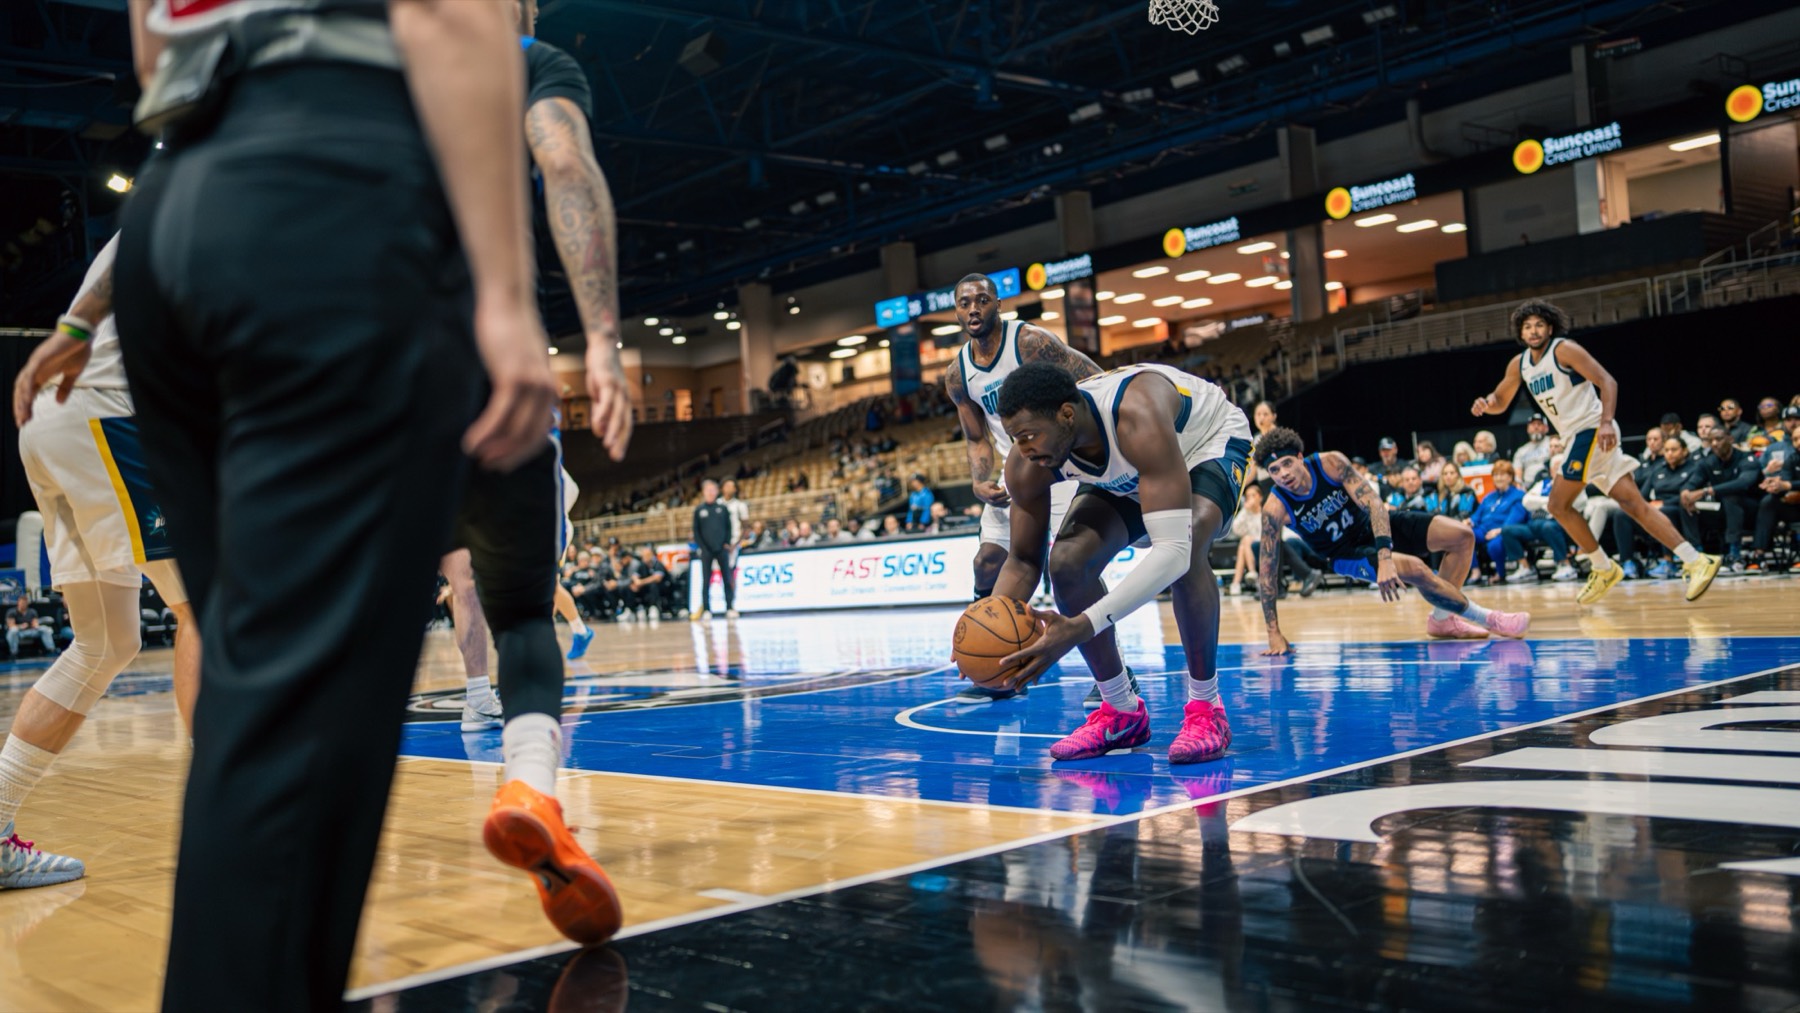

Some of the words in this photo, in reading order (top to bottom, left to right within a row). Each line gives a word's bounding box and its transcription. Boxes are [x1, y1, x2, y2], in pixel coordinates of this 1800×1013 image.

[1762, 79, 1800, 99] Sun
[1543, 122, 1621, 154] Suncoast
[1544, 147, 1582, 166] Credit
[1583, 138, 1622, 157] Union
[1350, 173, 1415, 201] Suncoast
[1352, 195, 1384, 212] Credit
[1384, 188, 1416, 205] Union
[1184, 217, 1239, 242] Suncoast
[1044, 253, 1091, 276] Suncoast
[981, 390, 998, 416] BO
[1326, 508, 1354, 542] 24
[831, 551, 946, 579] FASTSIGNS
